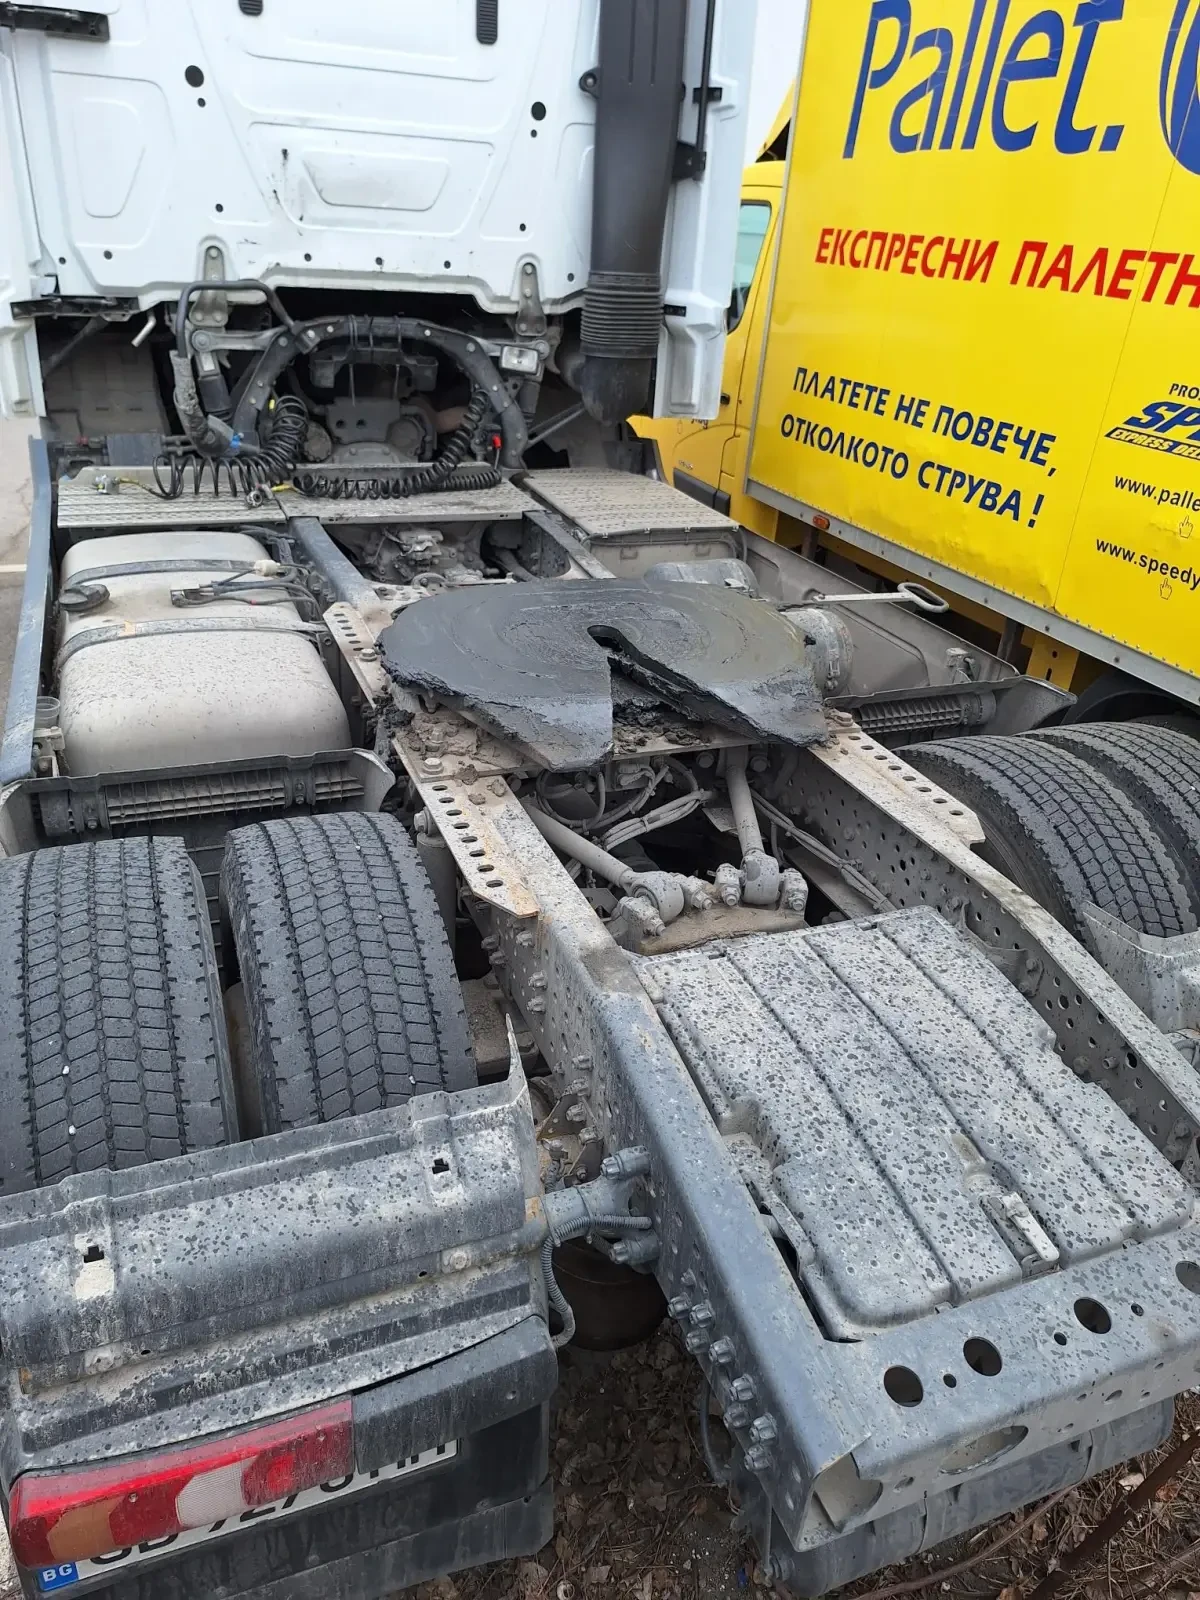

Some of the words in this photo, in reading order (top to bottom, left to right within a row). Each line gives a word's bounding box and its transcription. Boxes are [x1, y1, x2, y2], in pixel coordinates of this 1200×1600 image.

[843, 0, 1125, 159] Pallet.
[815, 228, 1000, 284] ЕКСПРЕСНИ
[780, 413, 909, 479] ОТКОЛКОТО
[793, 366, 891, 417] ПЛАТЕТЕ
[893, 394, 931, 429] НЕ
[932, 404, 1057, 477] ПОВЕЧЕ,
[1109, 428, 1174, 451] EXPRESS
[42, 1563, 73, 1582] BG
